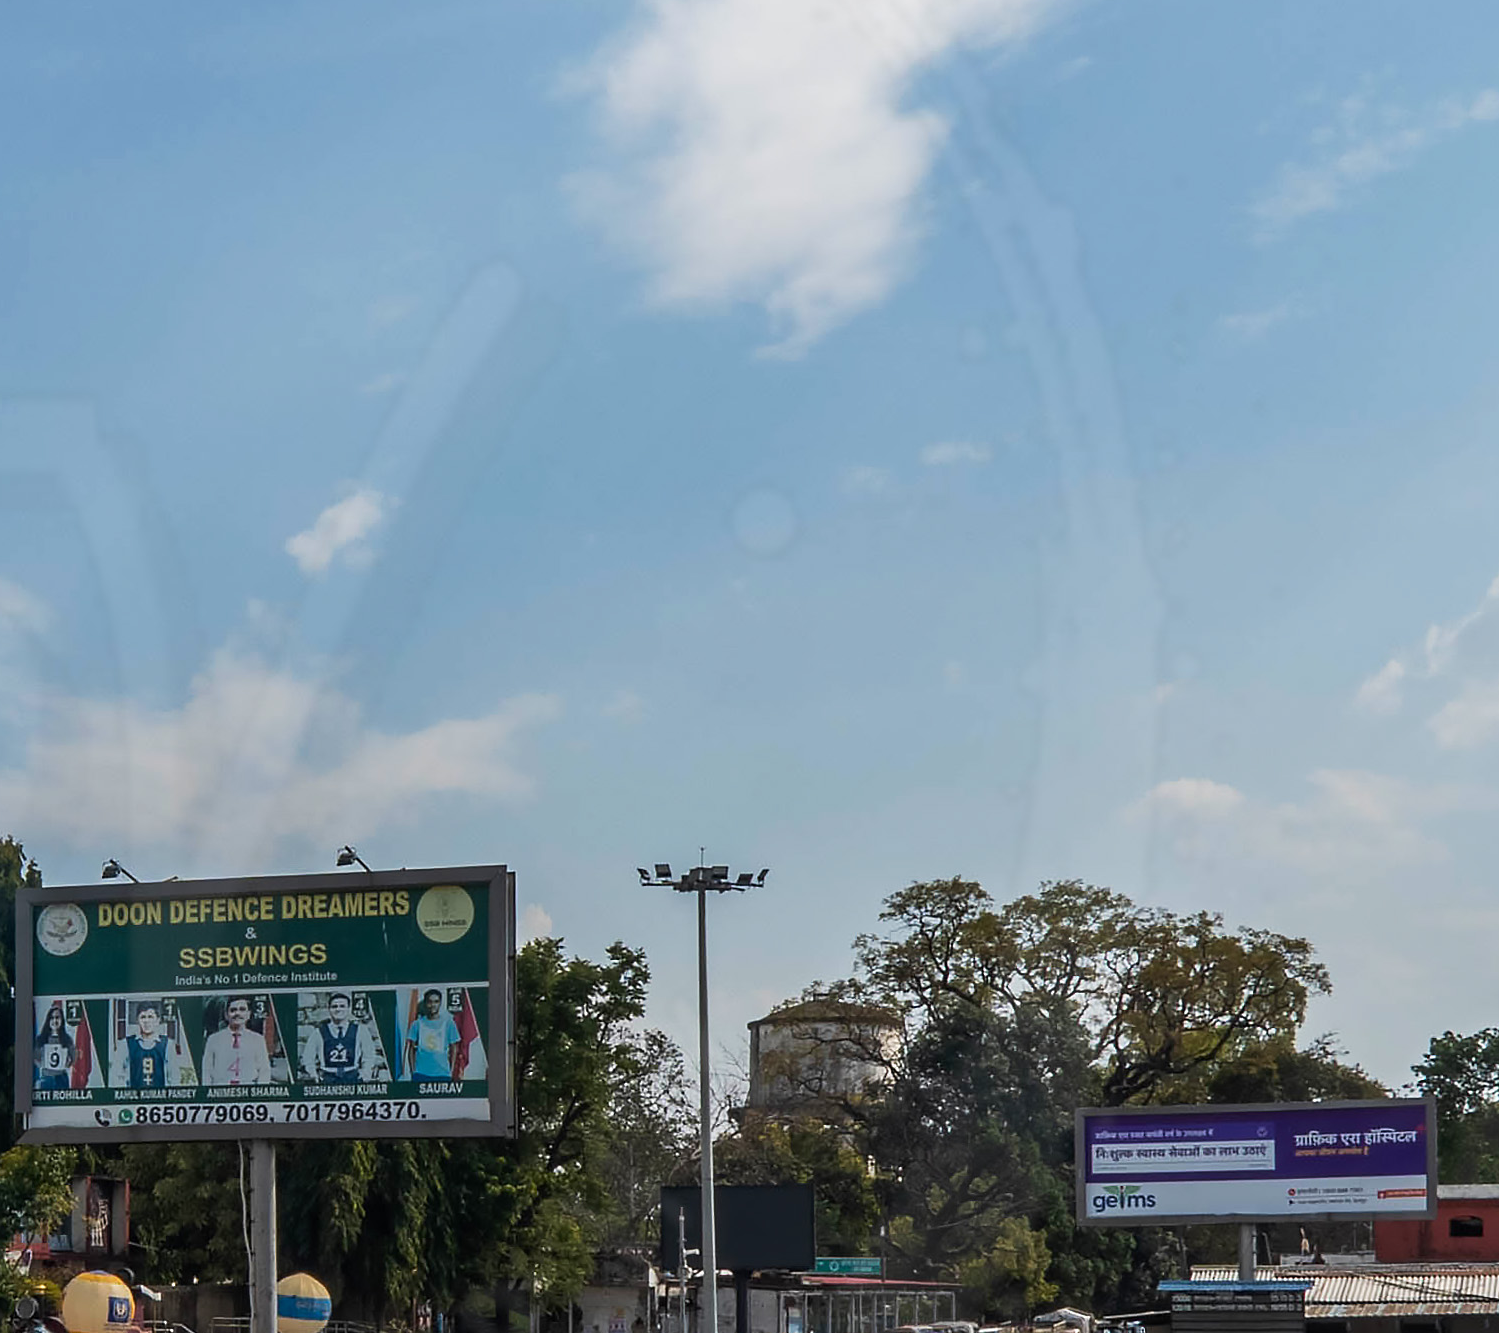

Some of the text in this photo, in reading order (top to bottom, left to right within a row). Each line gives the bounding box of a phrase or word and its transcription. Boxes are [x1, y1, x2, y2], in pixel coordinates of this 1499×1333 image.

[98, 891, 410, 927] DOON DEFENCE DREAMERS
[245, 927, 257, 939] &
[179, 944, 327, 968] SSBWINGS
[175, 975, 211, 986] India's
[214, 975, 229, 984] No
[243, 973, 288, 984] Defence
[291, 972, 338, 982] Institute
[50, 1053, 60, 1068] 9
[207, 1087, 289, 1098] ANIMESH SHARMA
[304, 1084, 388, 1095] SUDHANSHU KUMAR
[419, 1083, 464, 1094] SAURAV
[136, 1105, 274, 1123] 8650779069,
[1340, 1133, 1361, 1146] एरा
